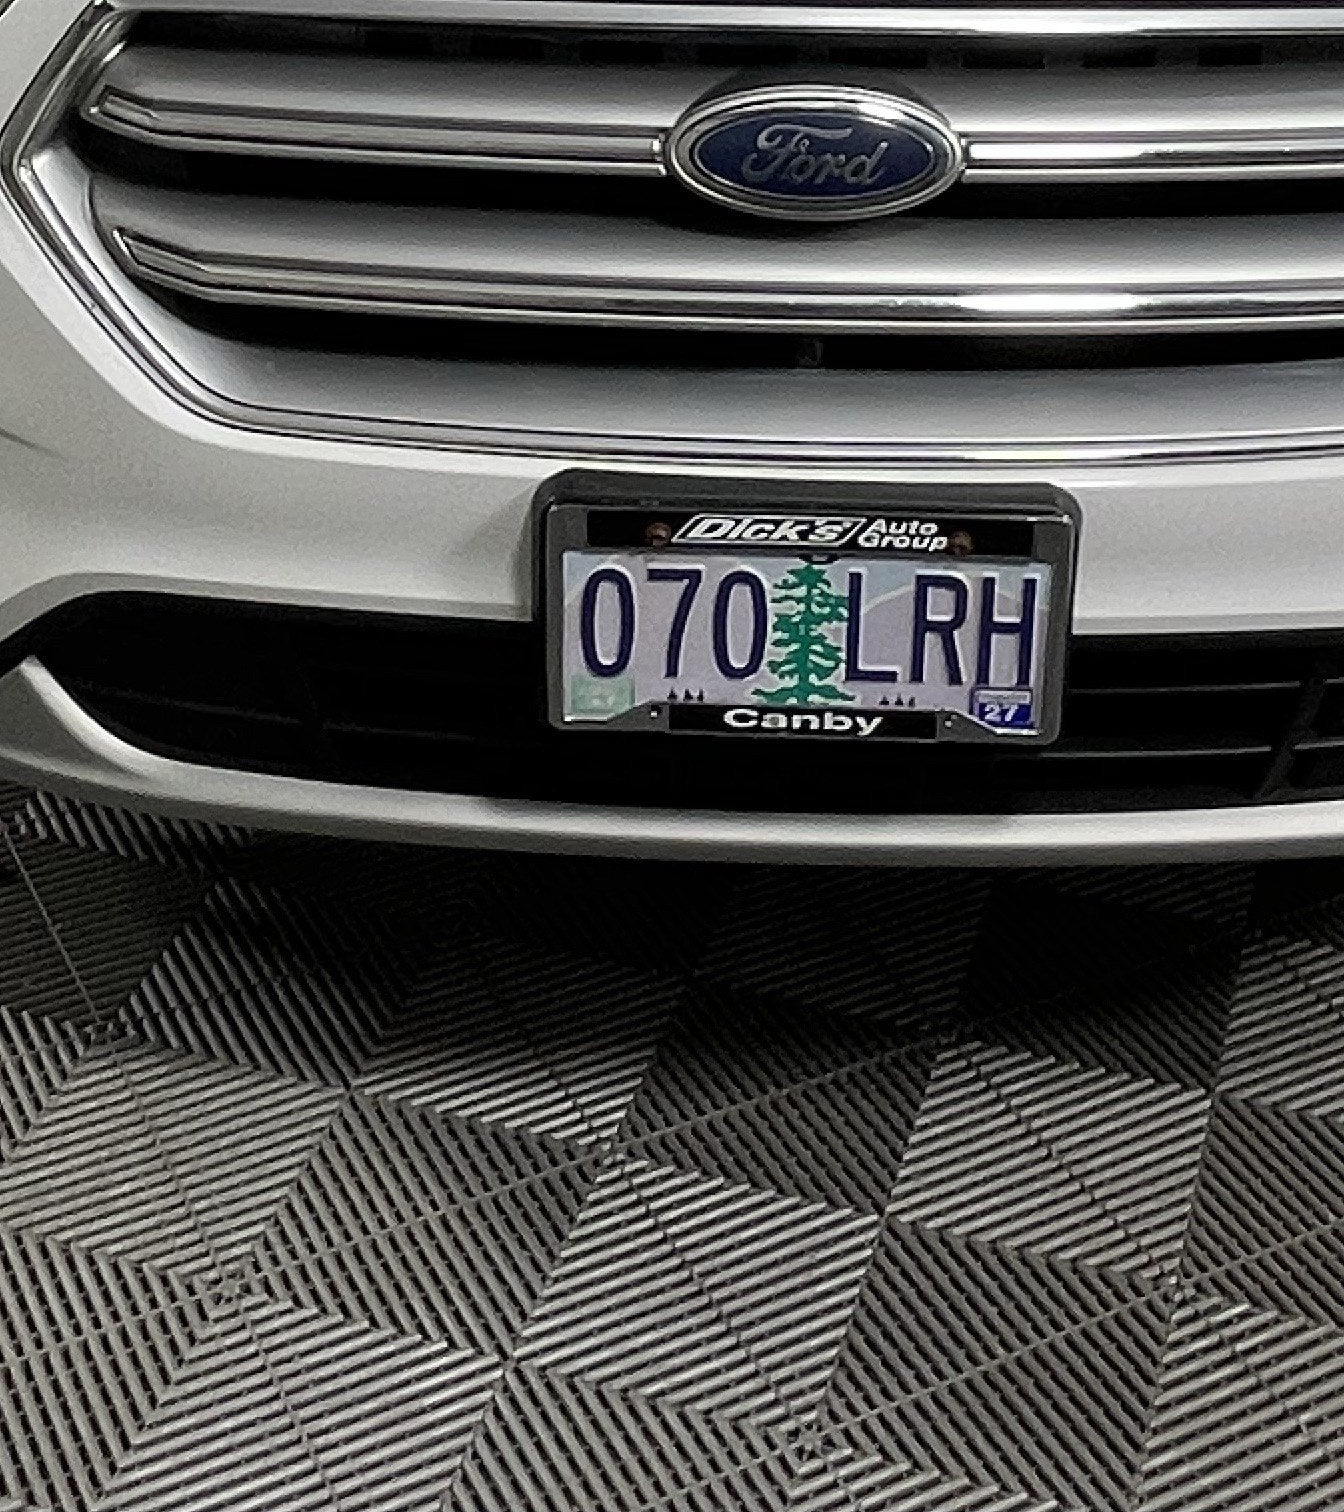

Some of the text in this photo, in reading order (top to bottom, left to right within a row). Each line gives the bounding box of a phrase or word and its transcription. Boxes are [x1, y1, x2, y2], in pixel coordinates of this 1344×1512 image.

[741, 124, 888, 184] Ford
[869, 518, 939, 536] Auto
[858, 533, 948, 551] Group
[580, 568, 1037, 687] 070 LRH
[723, 708, 884, 736] Canby
[984, 704, 1018, 722] 27
